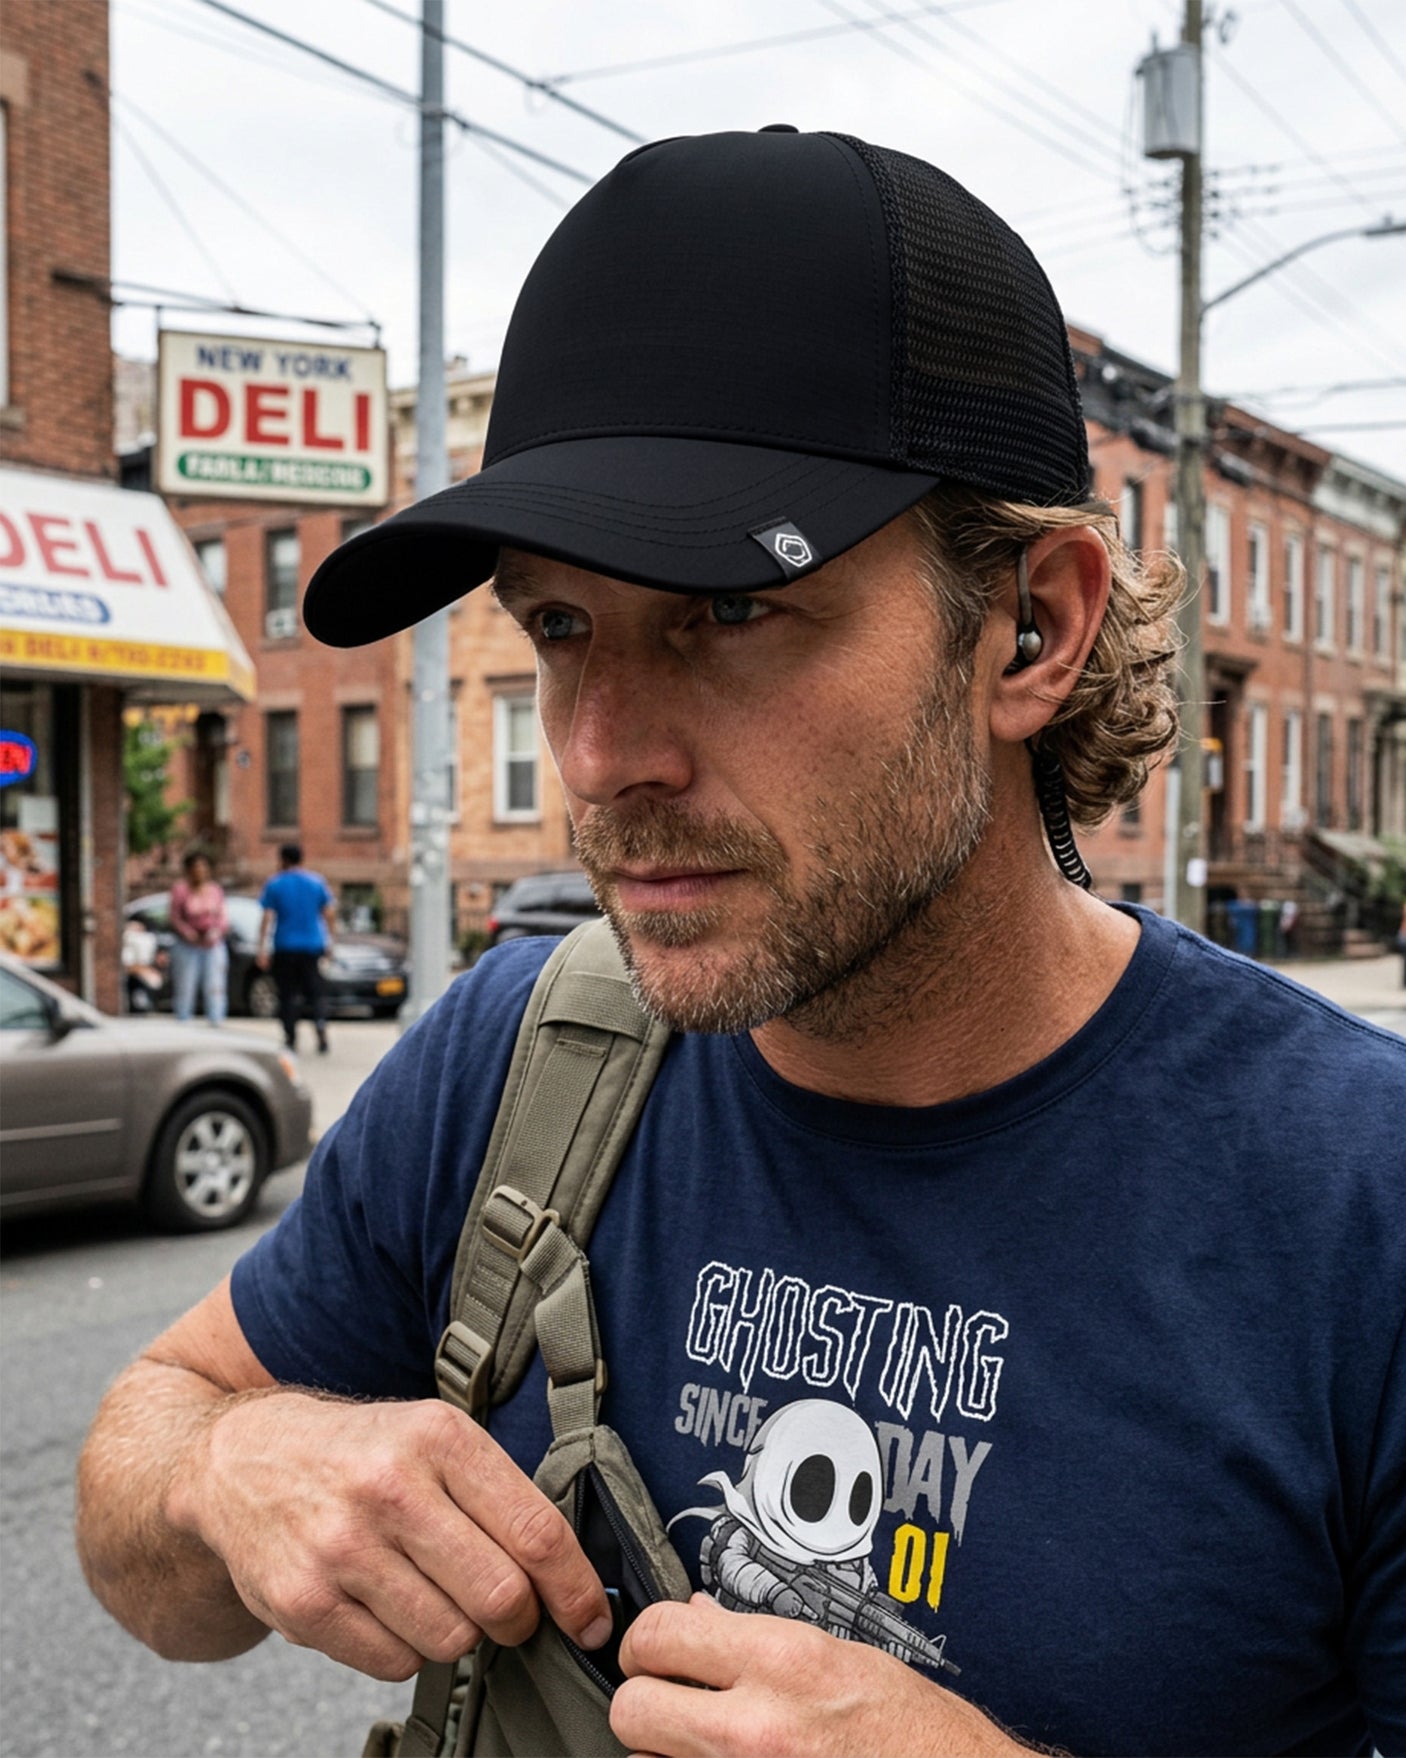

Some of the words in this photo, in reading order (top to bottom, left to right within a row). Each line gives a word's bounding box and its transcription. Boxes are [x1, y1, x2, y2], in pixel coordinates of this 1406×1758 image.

[179, 378, 370, 452] DELI
[198, 346, 262, 373] NEW
[277, 351, 351, 380] YORK
[686, 1260, 1009, 1422] GHOSTING
[674, 1382, 769, 1452] SINCE
[874, 1420, 993, 1547] DAY
